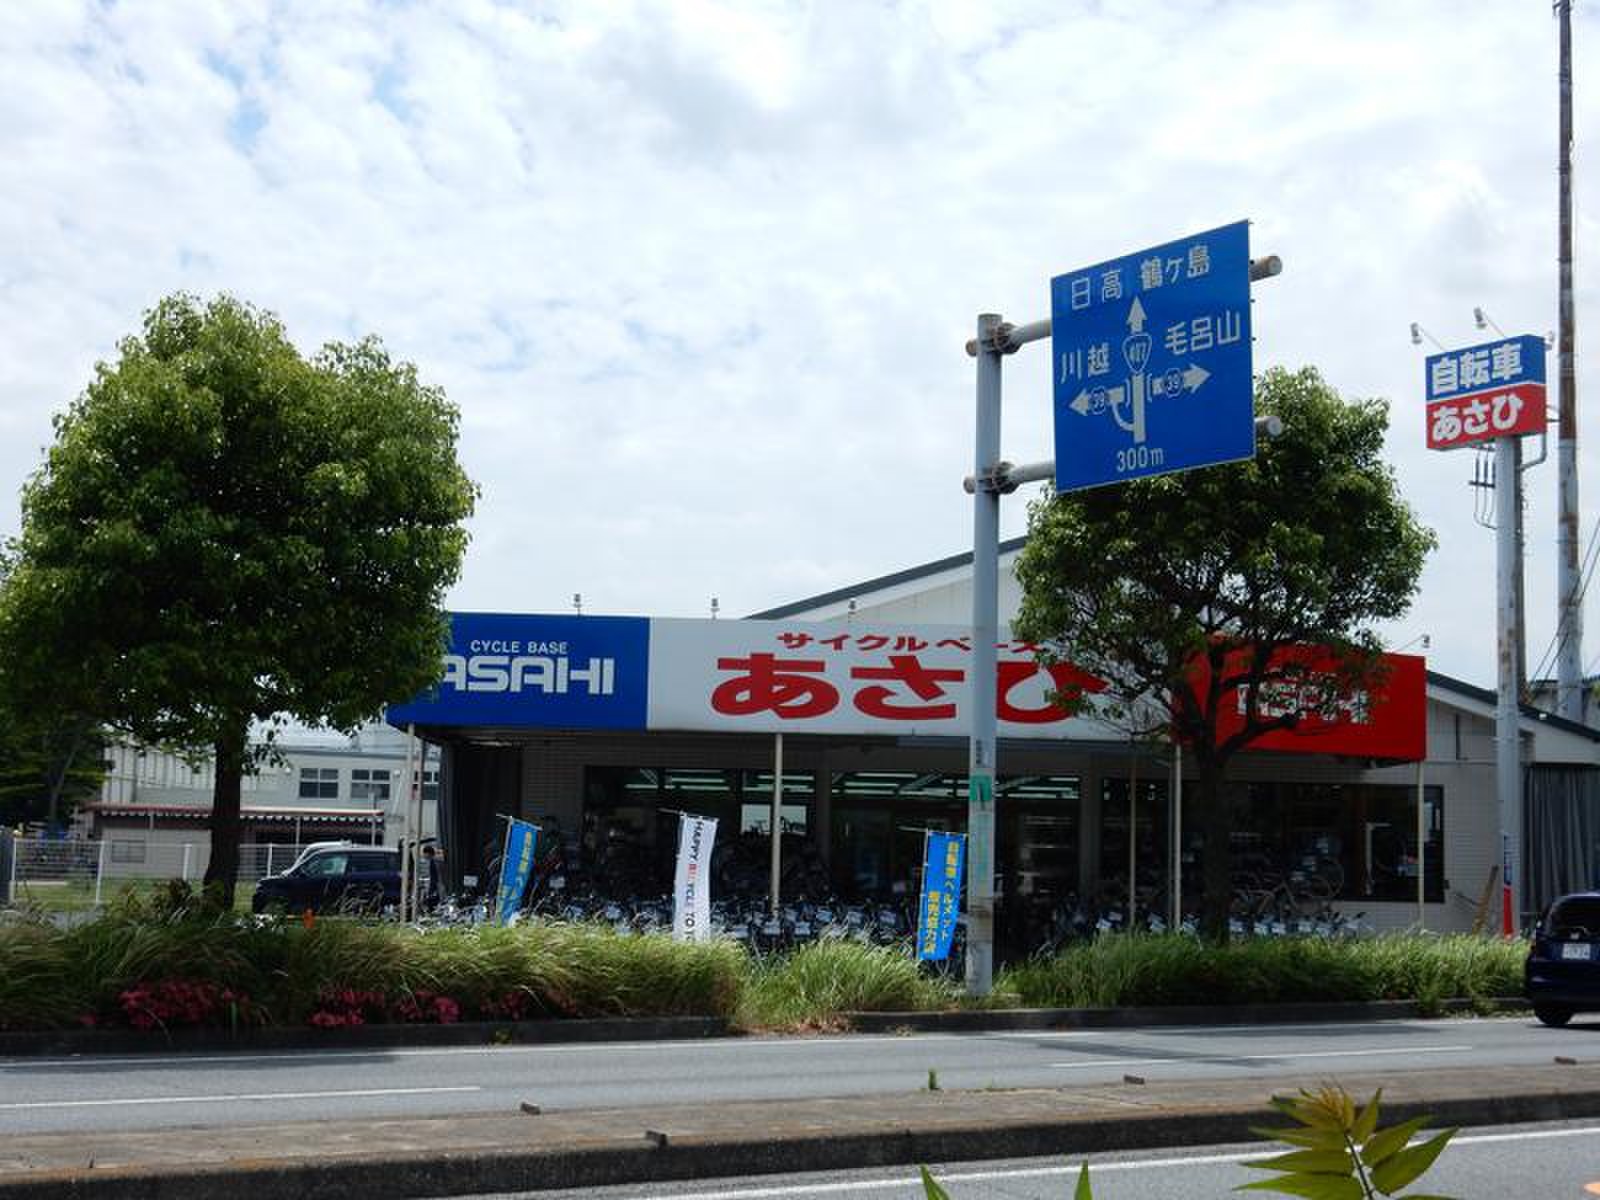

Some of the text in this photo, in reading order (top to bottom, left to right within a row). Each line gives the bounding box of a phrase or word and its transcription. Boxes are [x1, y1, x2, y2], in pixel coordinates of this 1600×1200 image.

[1071, 269, 1121, 310] 日高
[1165, 309, 1241, 356] 毛呂山
[1060, 343, 1110, 383] 川越
[1431, 343, 1523, 395] 自転車
[1432, 393, 1524, 442] あさひ
[470, 640, 569, 655] CYCLE BASE
[439, 655, 616, 696] ASAHI
[711, 653, 1112, 722] あさひ
[690, 820, 706, 861] HAPPY
